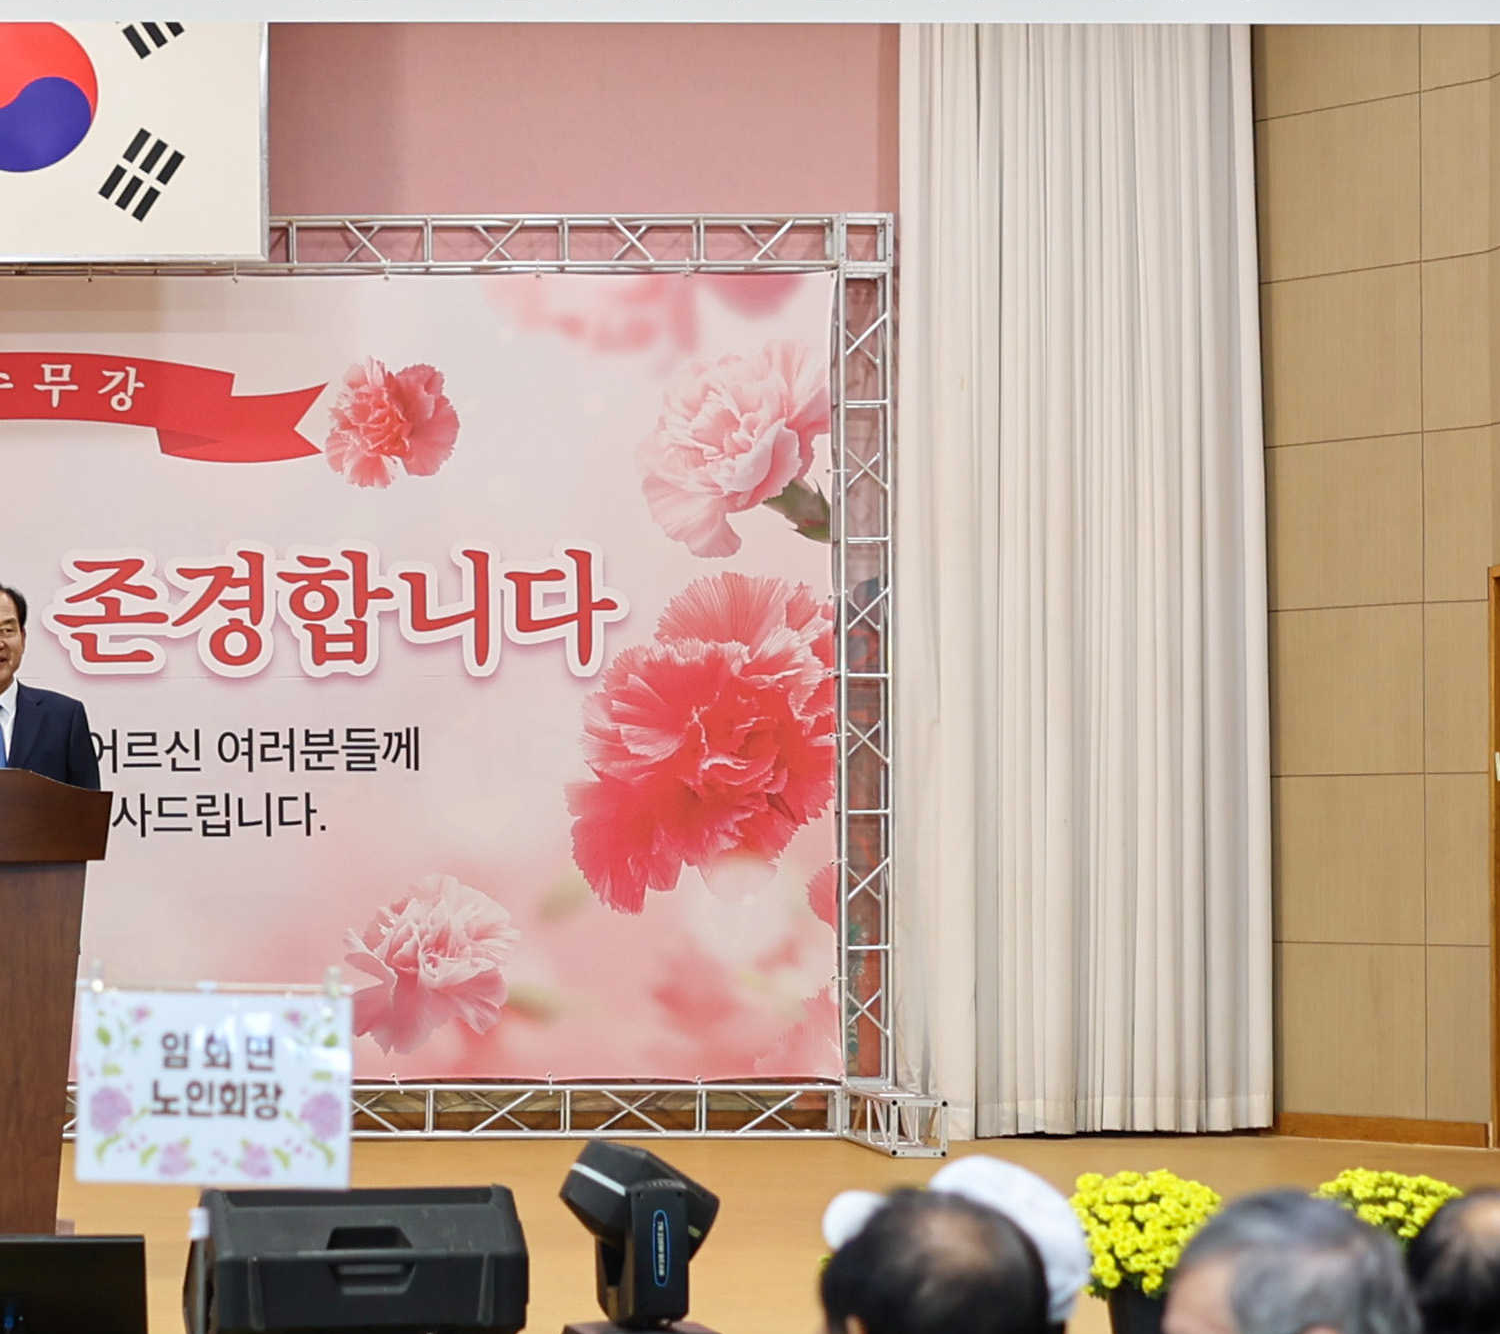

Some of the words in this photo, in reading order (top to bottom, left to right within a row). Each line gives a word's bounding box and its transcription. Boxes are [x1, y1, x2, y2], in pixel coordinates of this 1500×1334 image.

[53, 551, 612, 675] 존경합니다
[91, 728, 202, 774] 어르신
[217, 726, 421, 773] 여러분들께
[111, 791, 328, 839] 사드립니다.
[149, 1079, 284, 1120] 노인회장
